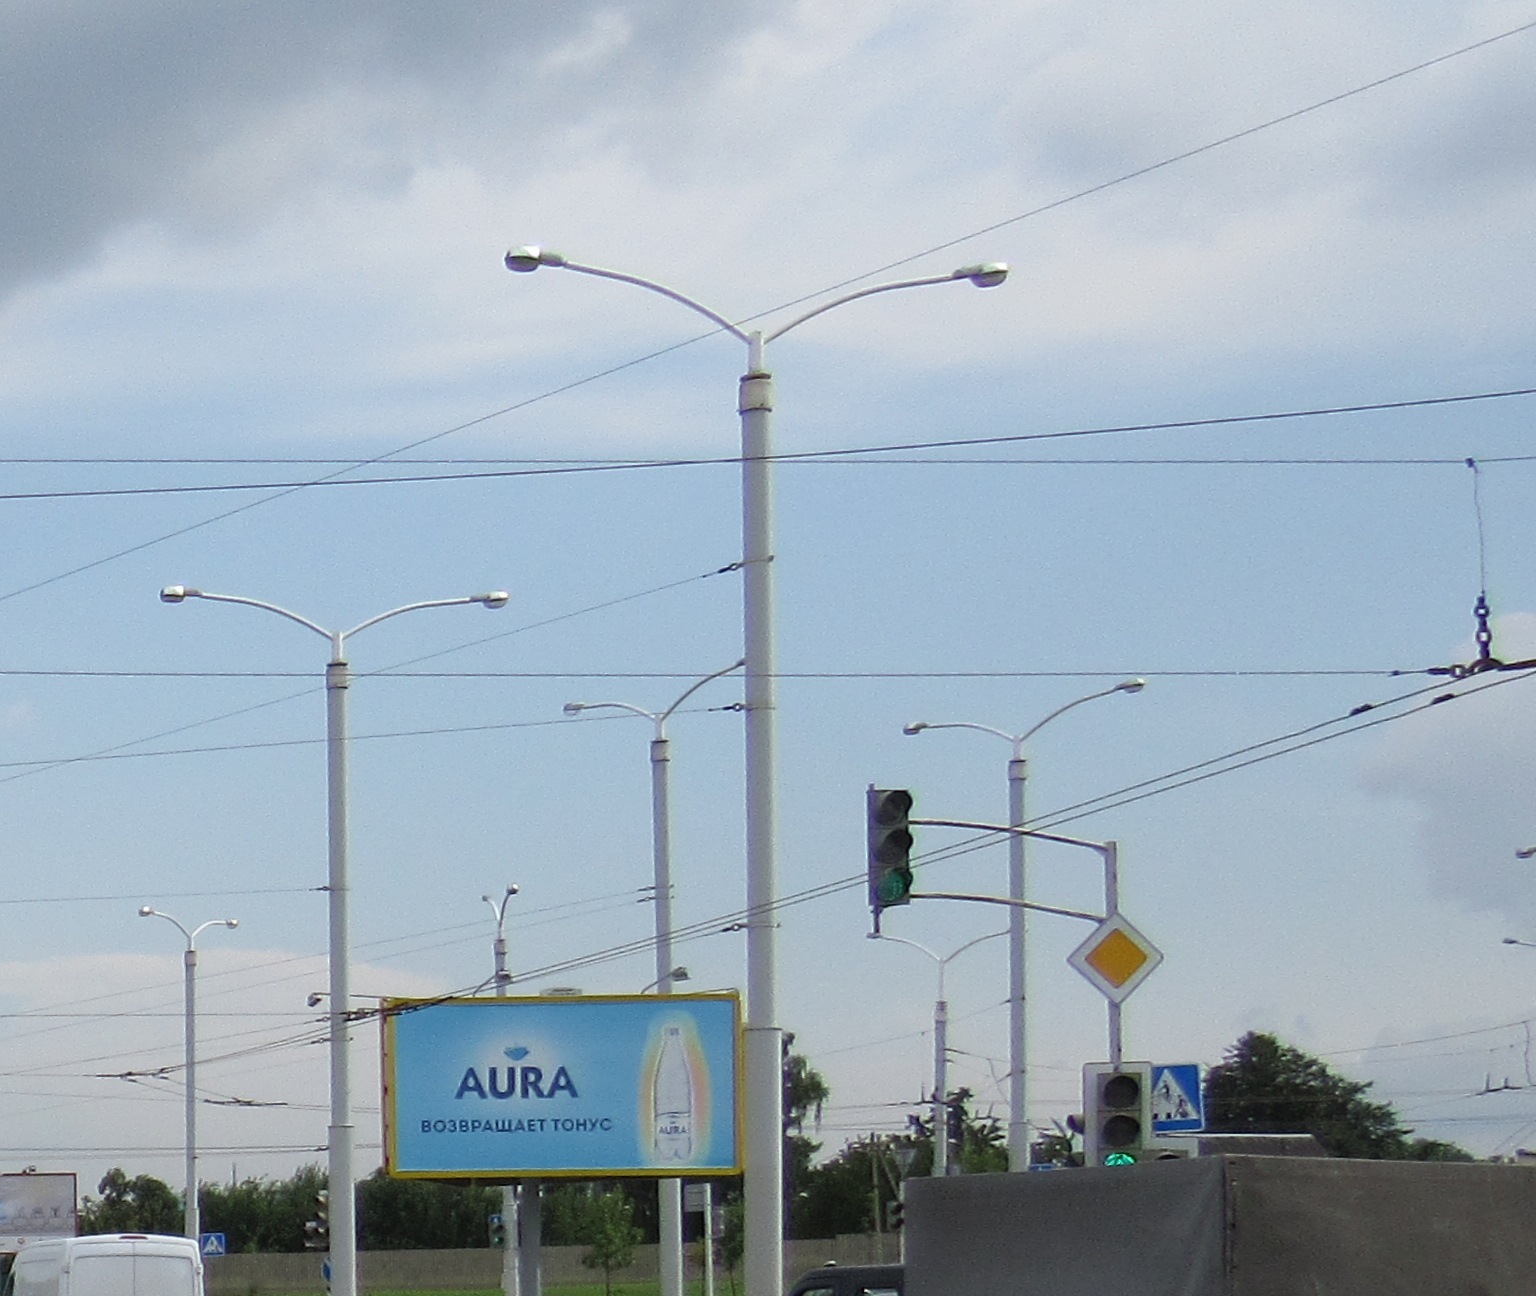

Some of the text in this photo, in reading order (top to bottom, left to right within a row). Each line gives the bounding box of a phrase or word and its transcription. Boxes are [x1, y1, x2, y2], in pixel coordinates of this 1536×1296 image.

[454, 1065, 579, 1100] AURA
[421, 1117, 613, 1134] ВОЗВРАЩАЕТ ТОНУС
[658, 1125, 688, 1135] AURA
